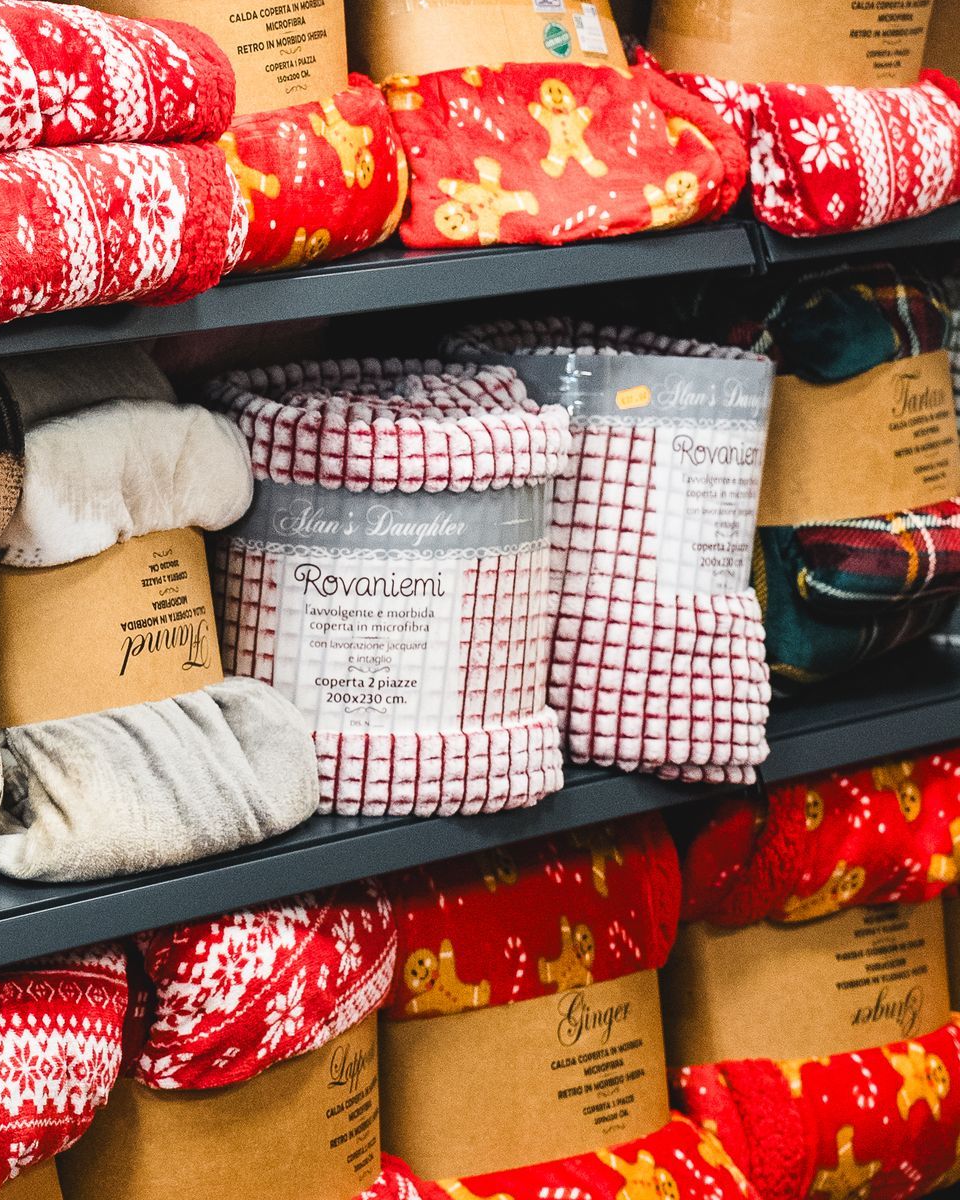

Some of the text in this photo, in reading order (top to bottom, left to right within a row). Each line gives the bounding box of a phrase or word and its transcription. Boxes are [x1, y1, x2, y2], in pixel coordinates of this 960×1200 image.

[229, 11, 258, 23] CALDA
[259, 4, 291, 19] COPERTA
[292, 2, 300, 12] IN
[265, 16, 306, 32] MICROFIBRA
[237, 29, 328, 55] RETRO IN MORBIDO SHERPA
[265, 55, 317, 73] COPERTA PIAZZA
[365, 504, 466, 547] Daughter
[141, 571, 188, 587] COPERTA PIAZZE
[293, 563, 445, 597] Rovaniemi
[152, 595, 188, 610] MICROFIBRA
[168, 608, 193, 622] COPERTA
[305, 603, 435, 621] l'avvolgente morbida
[120, 616, 159, 632] MORBIDA
[309, 621, 430, 634] coperta in microfibra
[119, 618, 211, 676] Flannel
[309, 639, 428, 652] con lavorazione jacquard
[356, 655, 392, 666] intaglio
[314, 676, 418, 690] coperta 2 piazze
[326, 692, 408, 704] 200x230 cm.
[557, 991, 630, 1047] Ginger
[551, 1048, 610, 1070] CALDA COPERTA
[558, 1075, 625, 1100] RETRO MORBIDO
